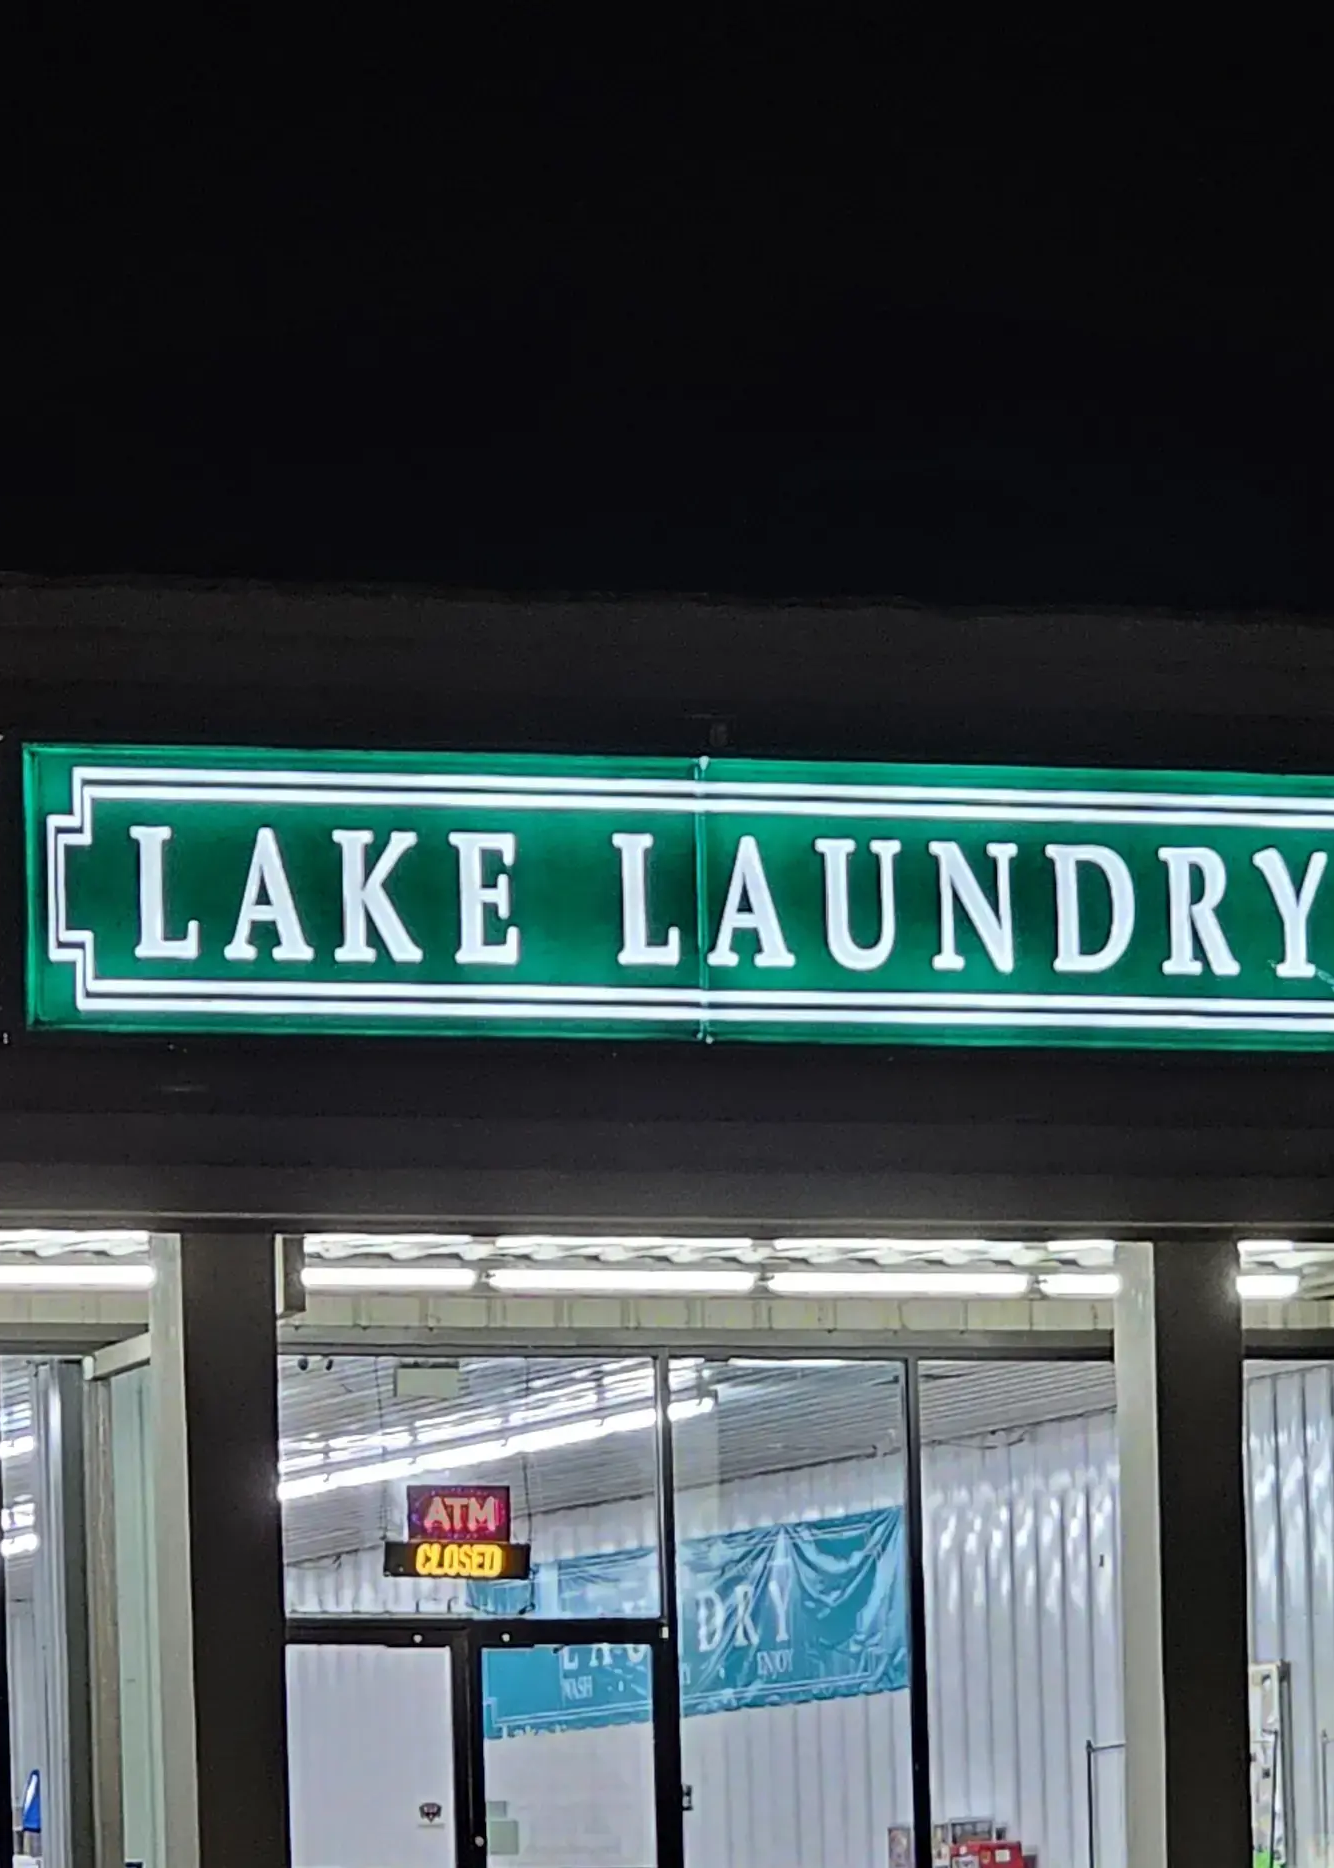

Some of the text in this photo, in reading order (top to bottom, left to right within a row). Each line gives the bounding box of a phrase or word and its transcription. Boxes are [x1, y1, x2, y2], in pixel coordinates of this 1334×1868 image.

[129, 825, 1328, 979] LAKE LAUNDRY
[424, 1496, 496, 1532] ATM
[416, 1543, 503, 1577] CLOSED
